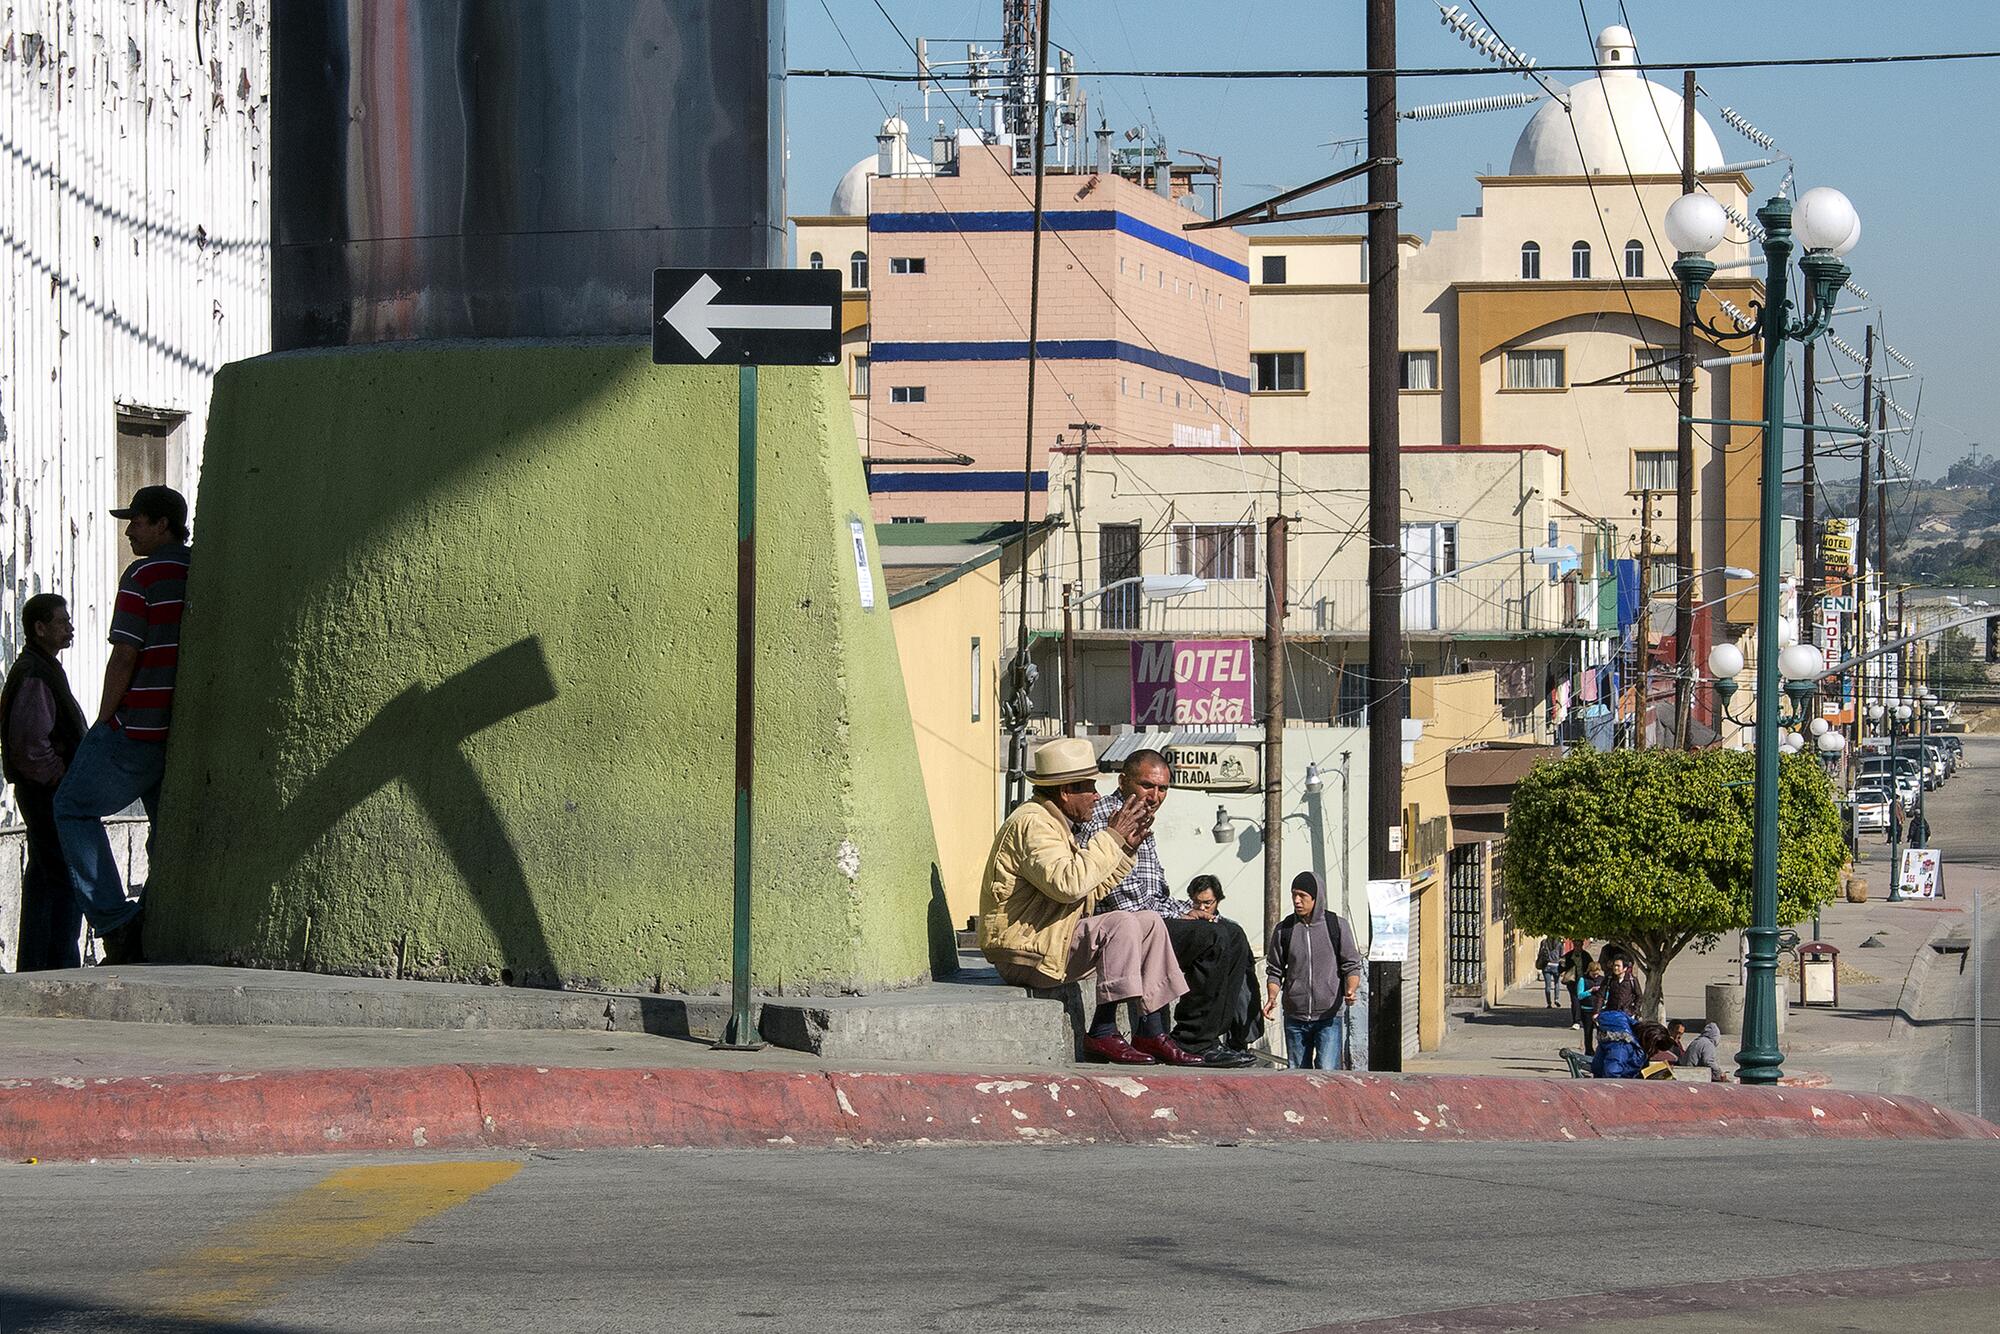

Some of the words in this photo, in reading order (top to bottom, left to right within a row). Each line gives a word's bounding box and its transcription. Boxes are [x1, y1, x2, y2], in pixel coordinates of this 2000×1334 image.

[1823, 554, 1849, 564] ORONA
[1137, 642, 1246, 683] MOTEL
[1137, 687, 1244, 724] Alaska
[1165, 751, 1218, 765] OFICINA
[1170, 771, 1211, 784] NTRADA
